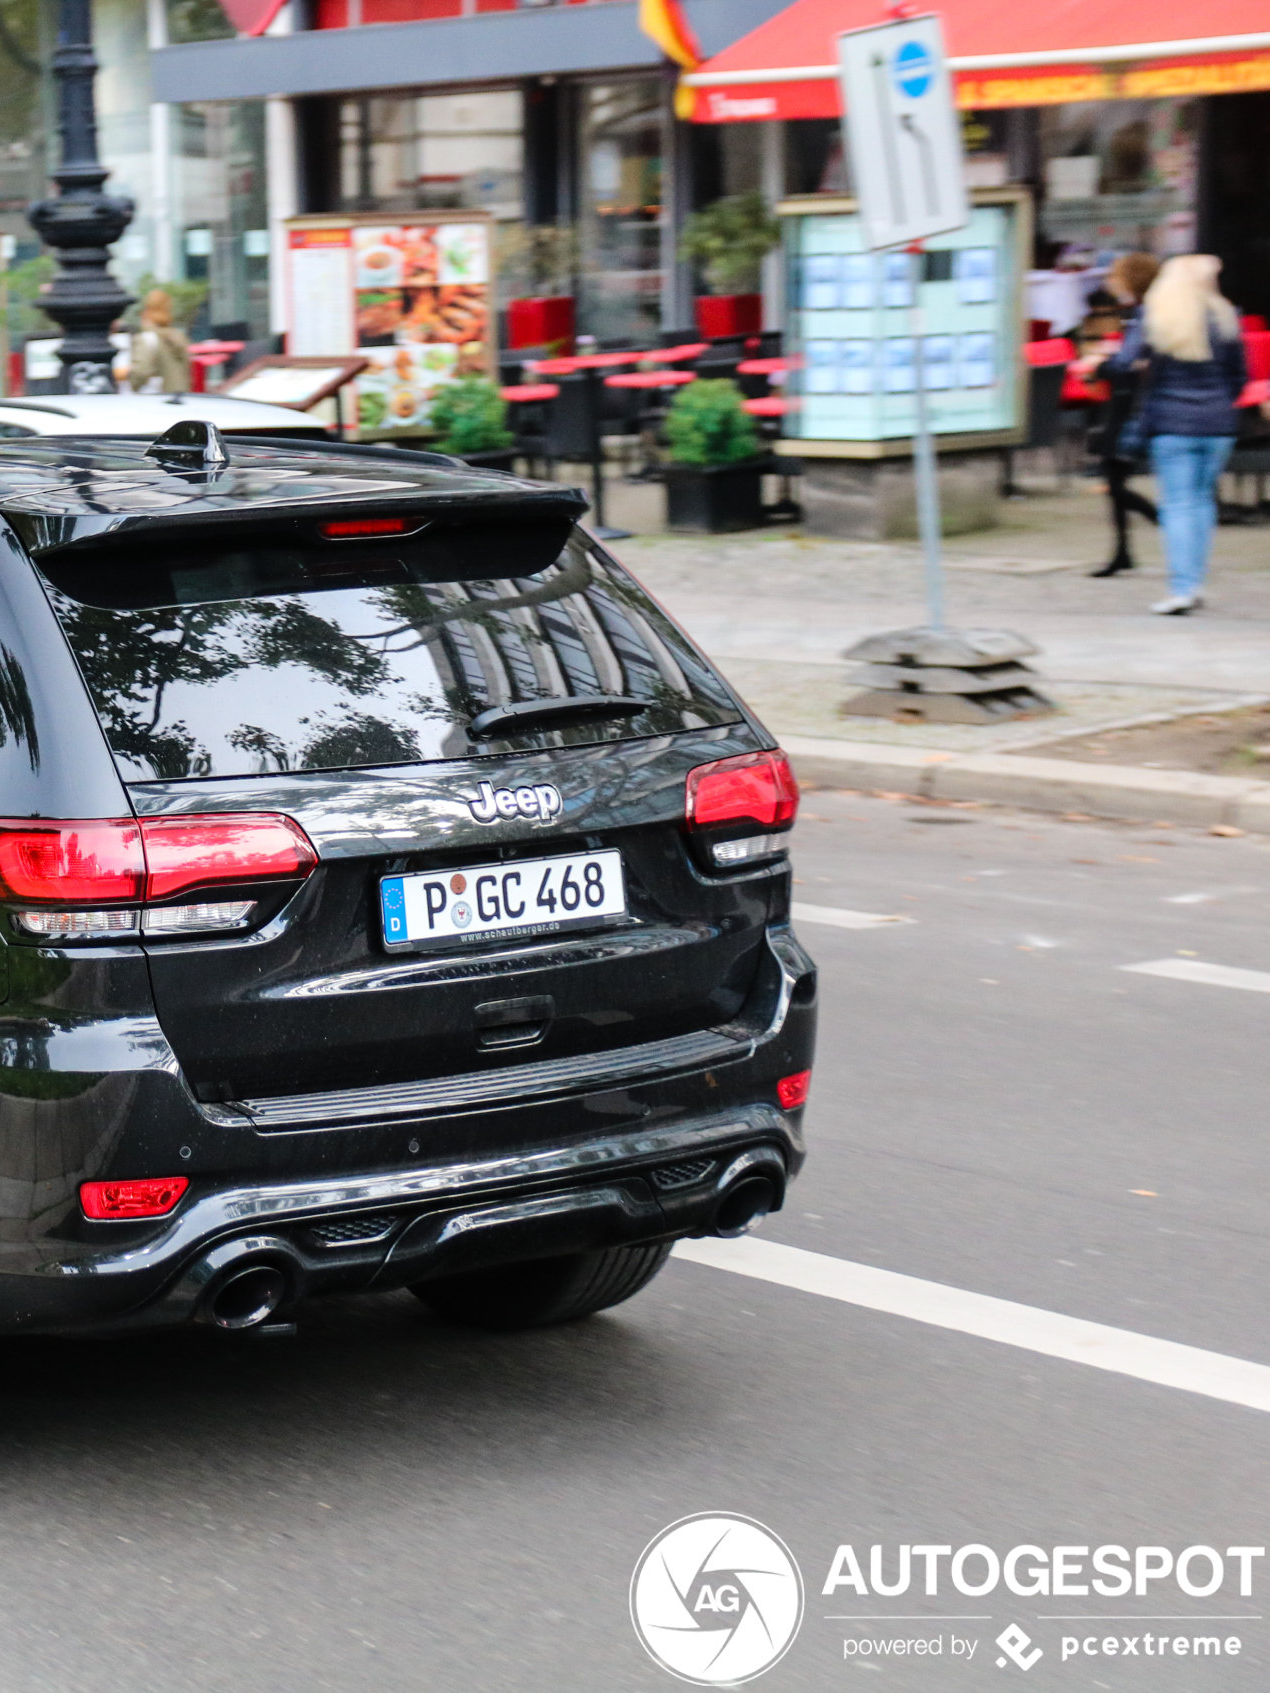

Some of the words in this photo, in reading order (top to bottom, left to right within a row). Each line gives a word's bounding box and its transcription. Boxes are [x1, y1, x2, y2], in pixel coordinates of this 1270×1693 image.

[468, 780, 563, 826] Jeep
[423, 881, 447, 929] P
[476, 871, 526, 922] GC
[536, 862, 605, 913] 468
[390, 917, 401, 932] D
